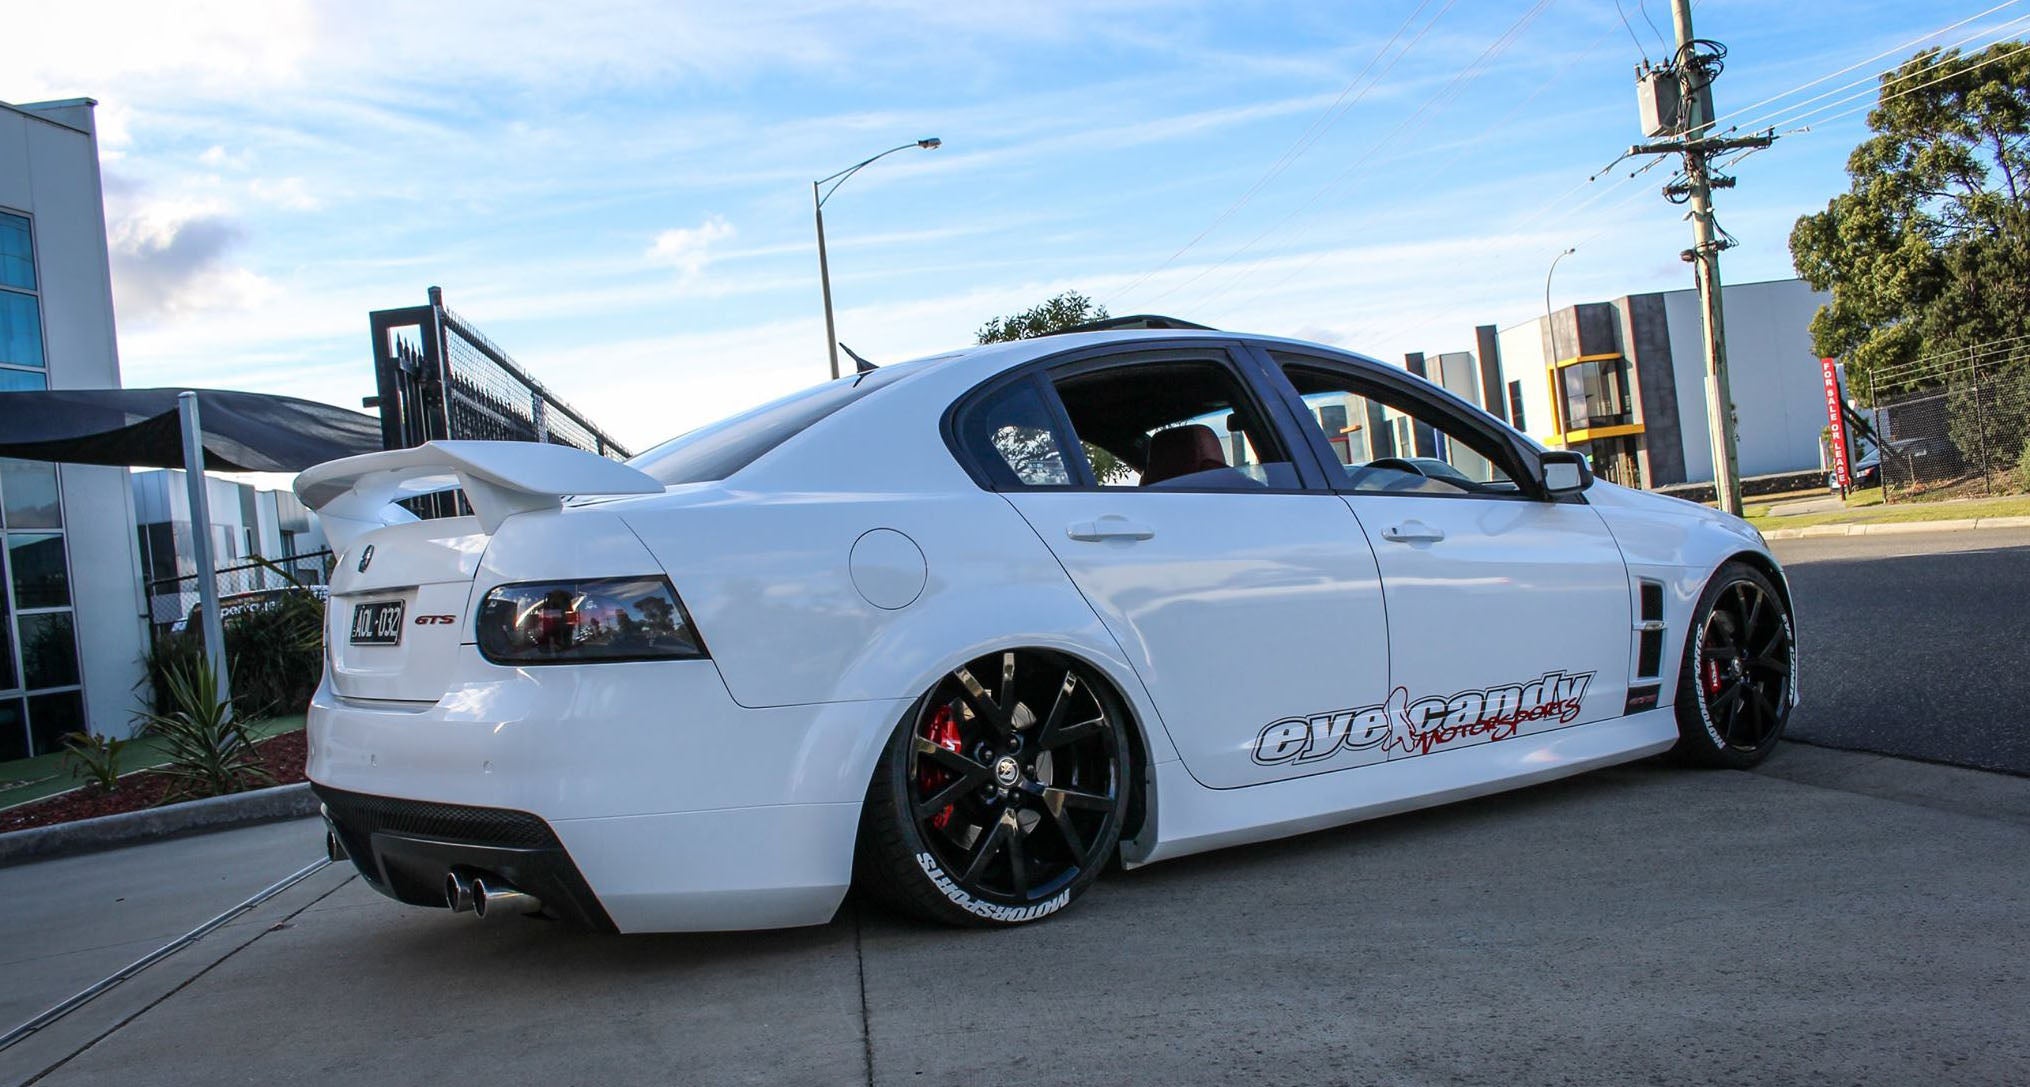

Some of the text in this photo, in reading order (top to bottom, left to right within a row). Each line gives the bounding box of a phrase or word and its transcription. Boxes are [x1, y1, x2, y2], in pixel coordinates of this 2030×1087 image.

[1823, 363, 1846, 482] FOR SALE OR LEASE
[414, 614, 457, 625] GTS
[1251, 669, 1598, 766] eye candy
[1693, 623, 1726, 750] MOTORSPORTS
[916, 851, 1070, 922] MOTORSPORTS
